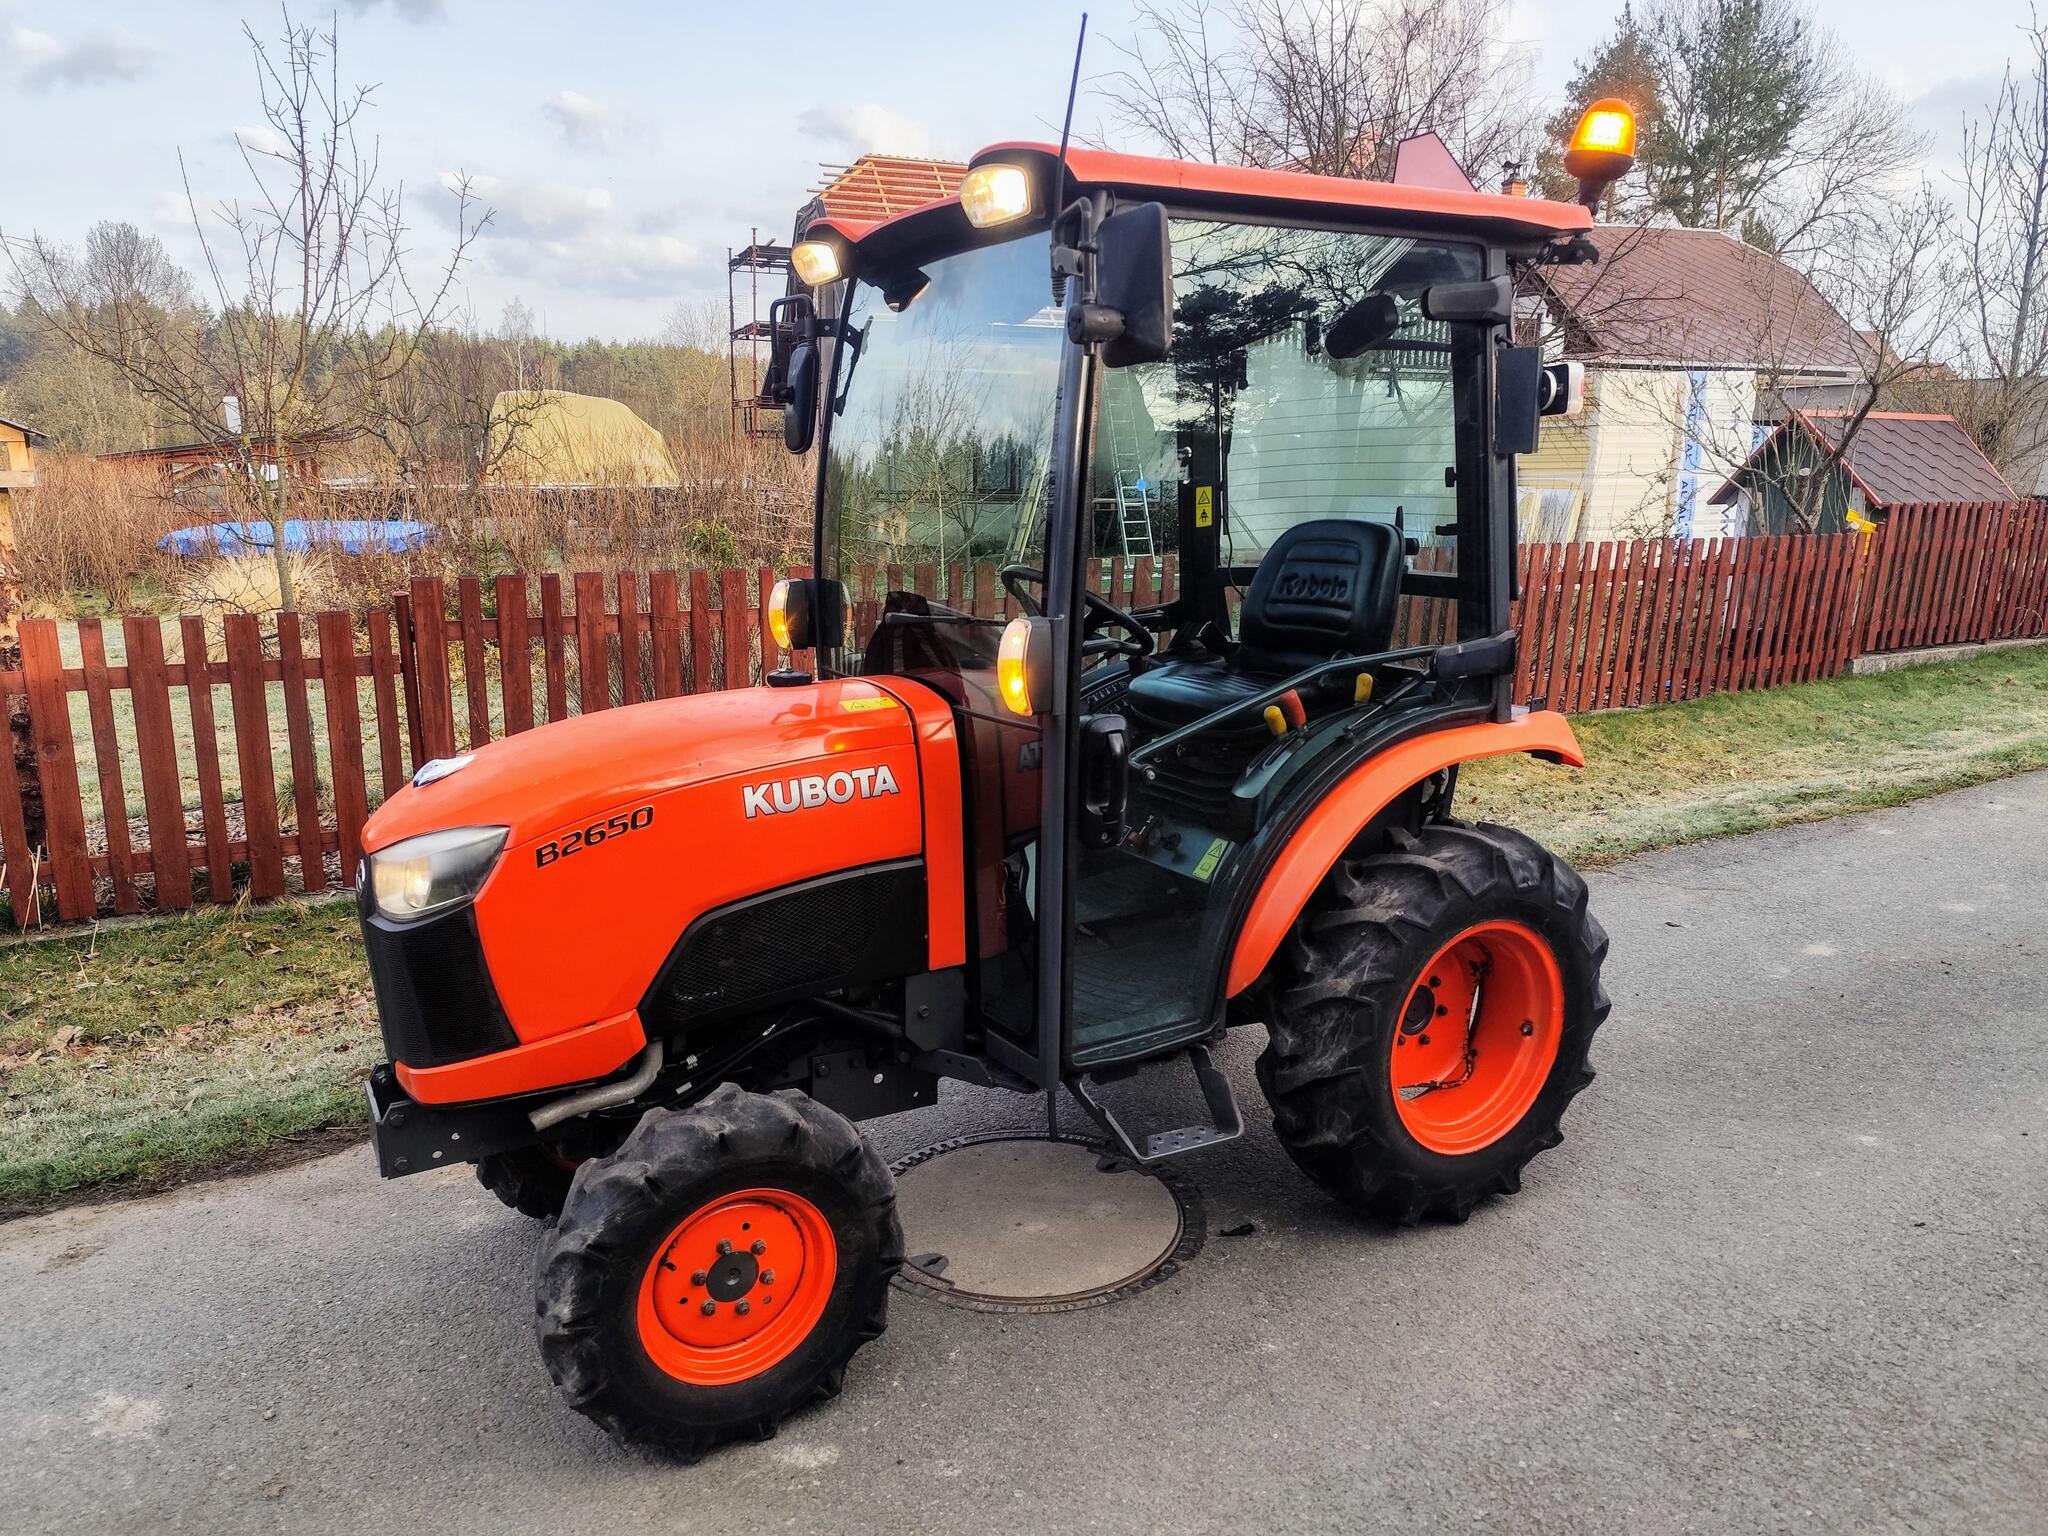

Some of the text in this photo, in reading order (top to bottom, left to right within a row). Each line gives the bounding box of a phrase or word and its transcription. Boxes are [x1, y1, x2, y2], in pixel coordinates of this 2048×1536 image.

[1681, 480, 1689, 498] AL
[742, 764, 900, 818] KUBOTA
[535, 805, 654, 869] B2650
